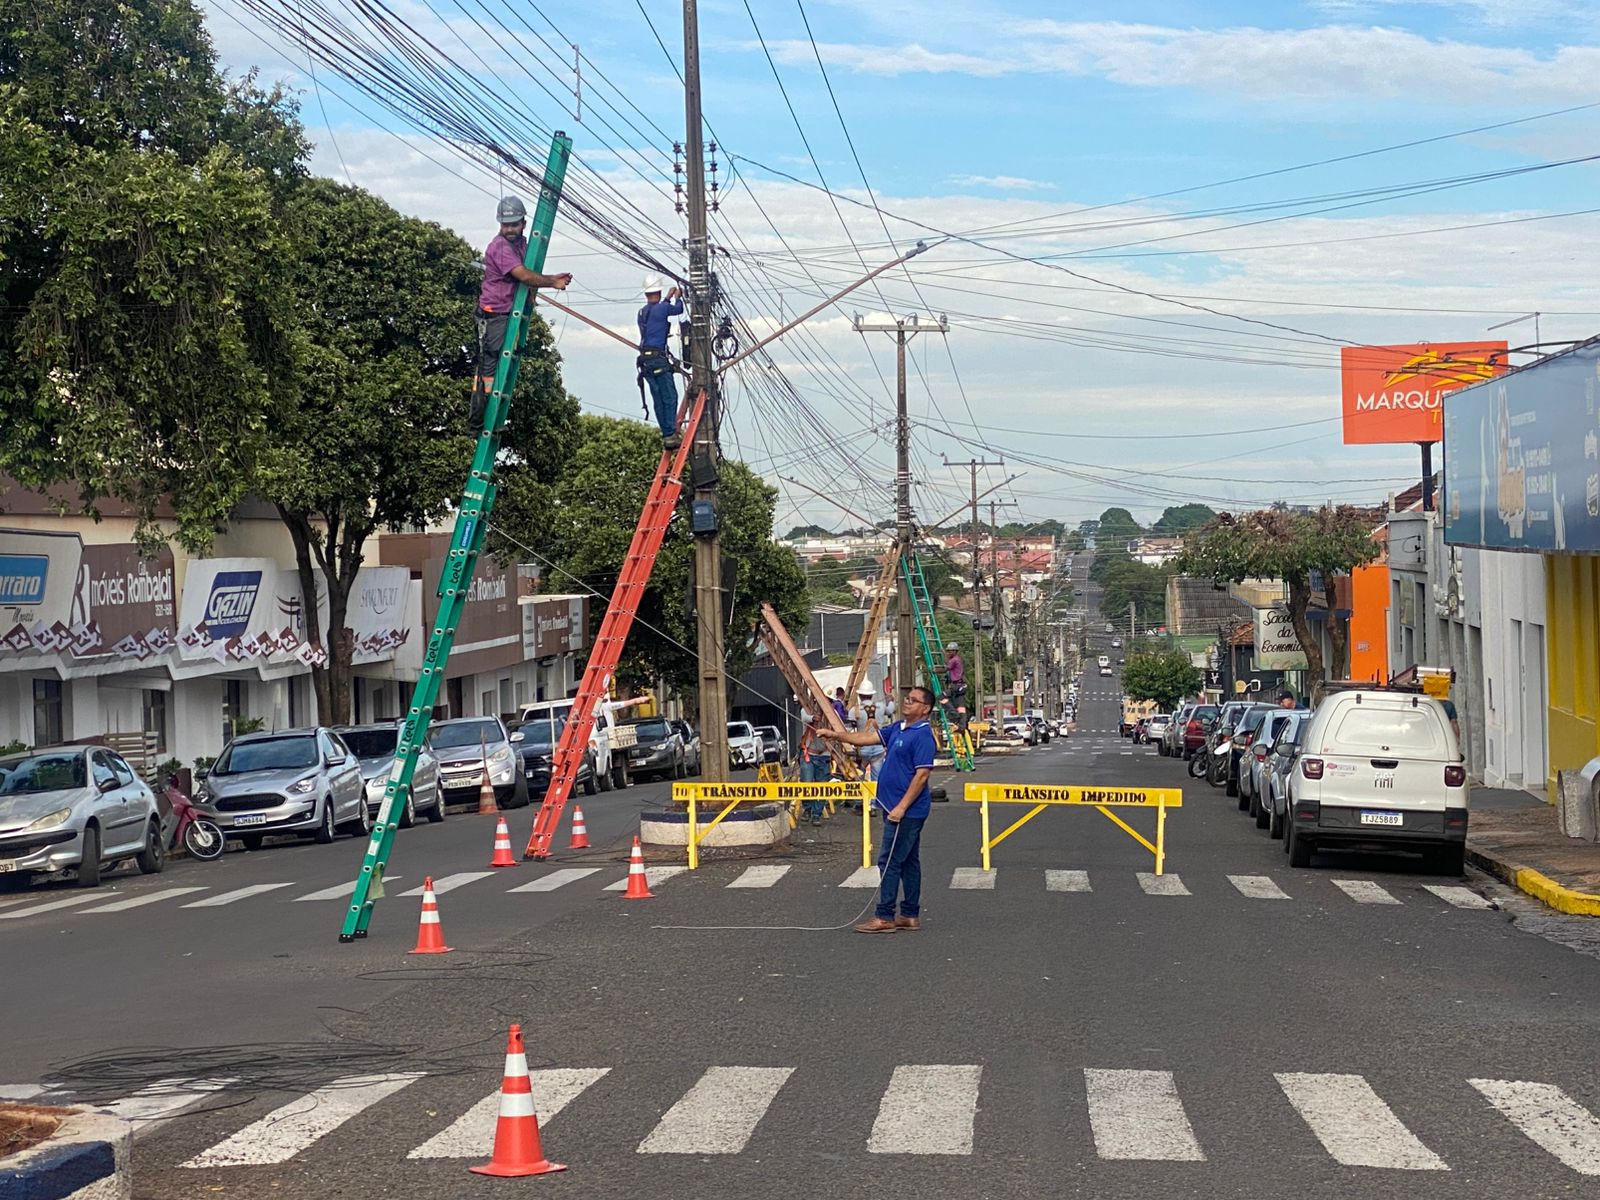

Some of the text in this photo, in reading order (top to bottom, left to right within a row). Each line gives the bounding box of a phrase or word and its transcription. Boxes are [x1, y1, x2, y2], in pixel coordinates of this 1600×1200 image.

[91, 571, 125, 607] móveis
[127, 568, 172, 604] Rombaldi
[1277, 625, 1295, 638] da
[701, 784, 767, 798] TRÂNSITO
[778, 786, 842, 798] IMPEDIDO
[1003, 787, 1147, 803] TRÂNSITO IMPEDIDO
